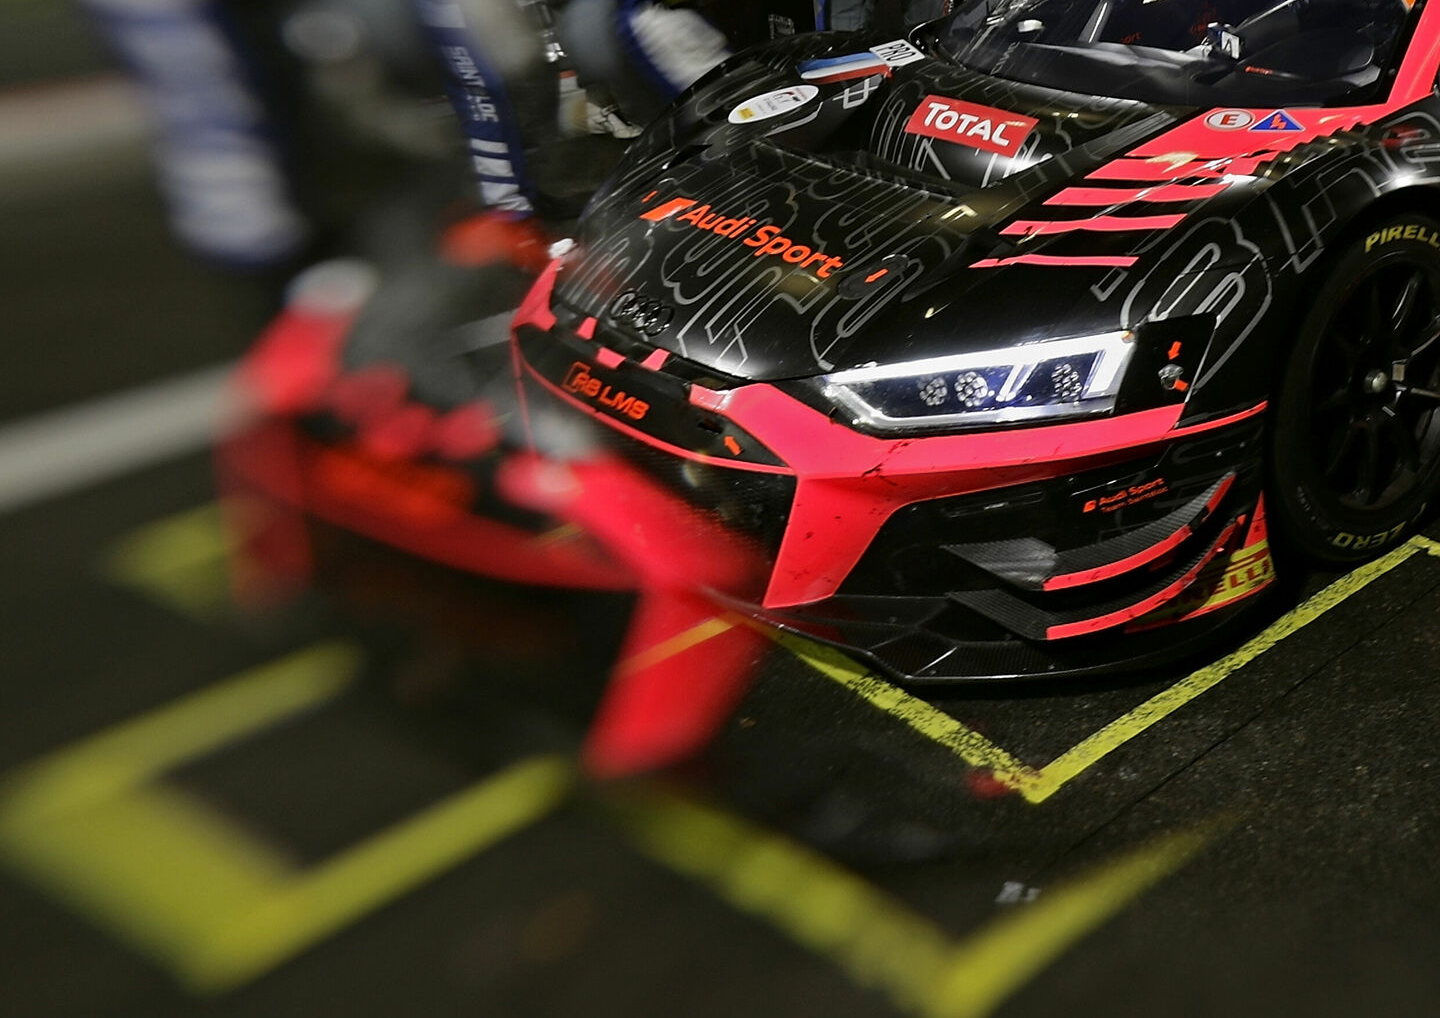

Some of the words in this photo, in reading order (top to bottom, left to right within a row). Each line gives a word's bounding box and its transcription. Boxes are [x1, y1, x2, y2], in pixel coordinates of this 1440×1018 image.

[875, 42, 917, 63] PRO
[923, 101, 1010, 147] TOTAL
[676, 204, 758, 239] Audi
[743, 224, 843, 278] Sport
